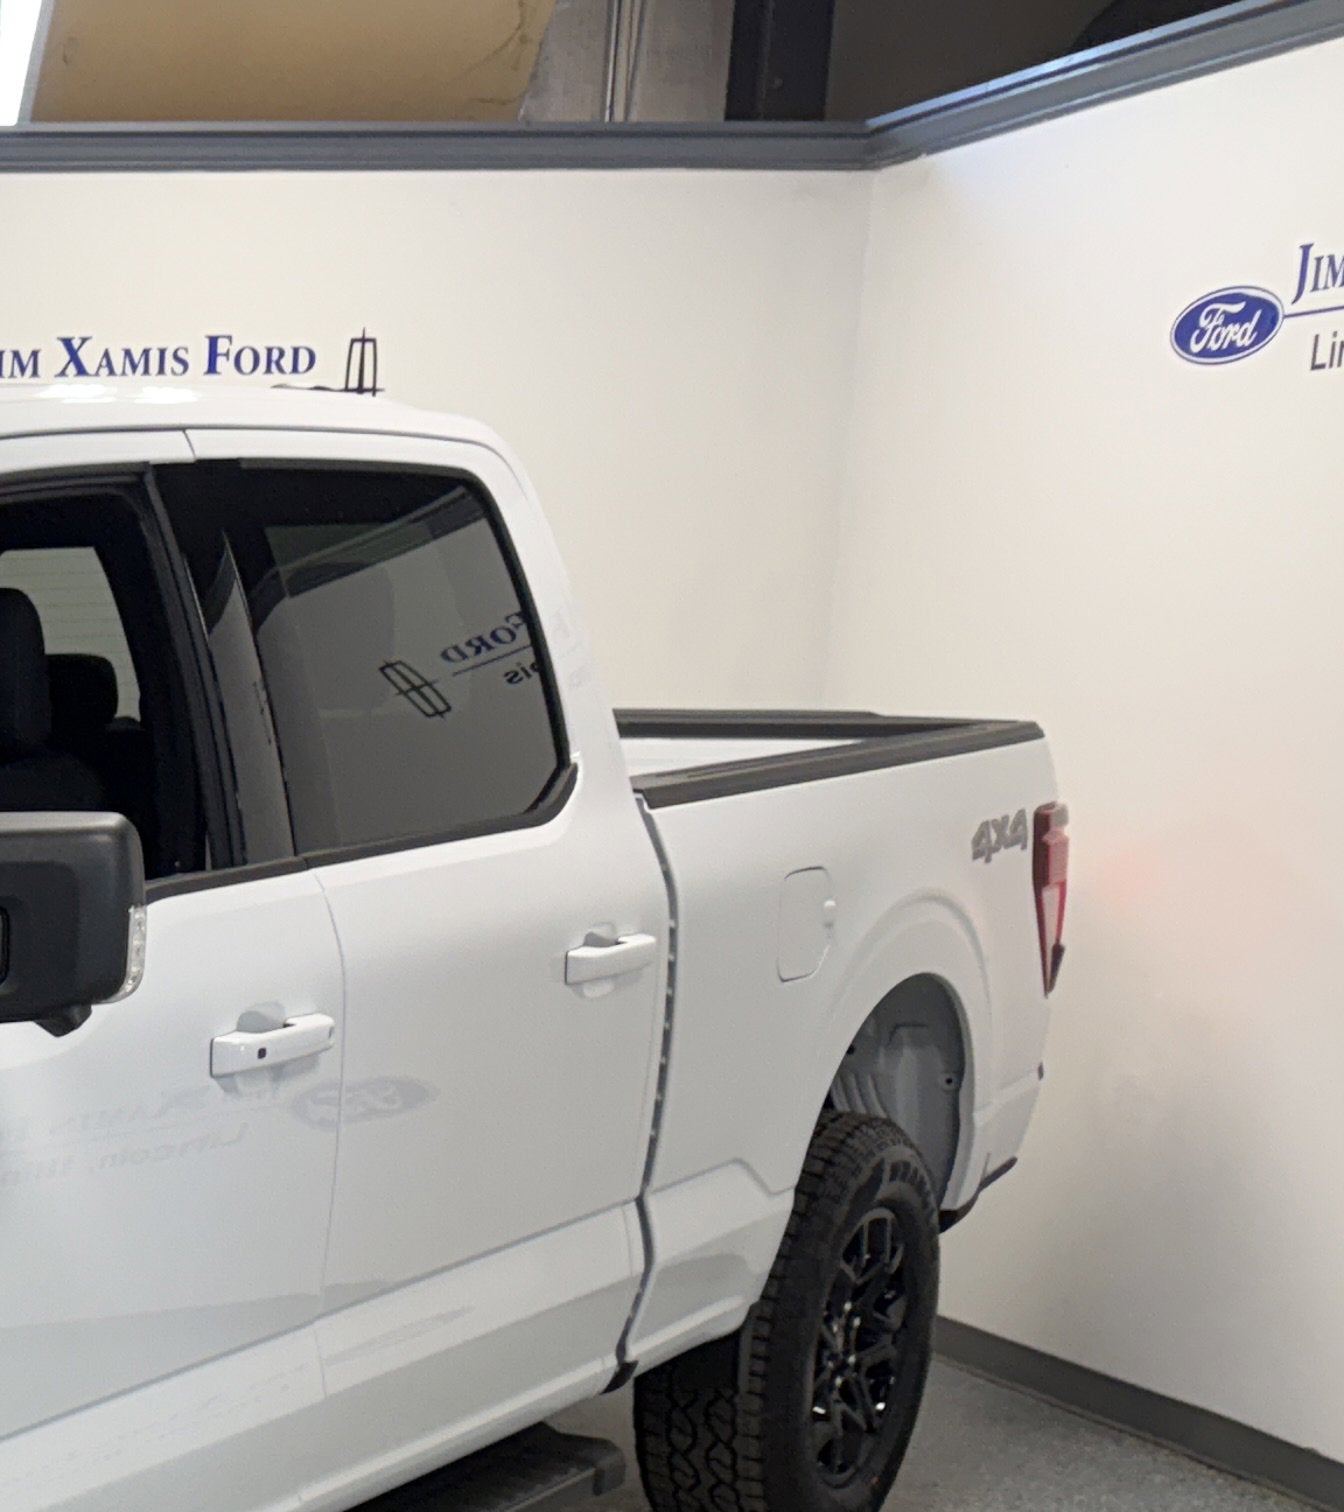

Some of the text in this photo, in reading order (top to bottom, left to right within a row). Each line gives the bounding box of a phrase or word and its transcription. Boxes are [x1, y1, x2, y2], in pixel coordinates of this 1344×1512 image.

[1190, 301, 1262, 354] Ford
[54, 335, 189, 378] XAMIS
[203, 333, 316, 376] FORD
